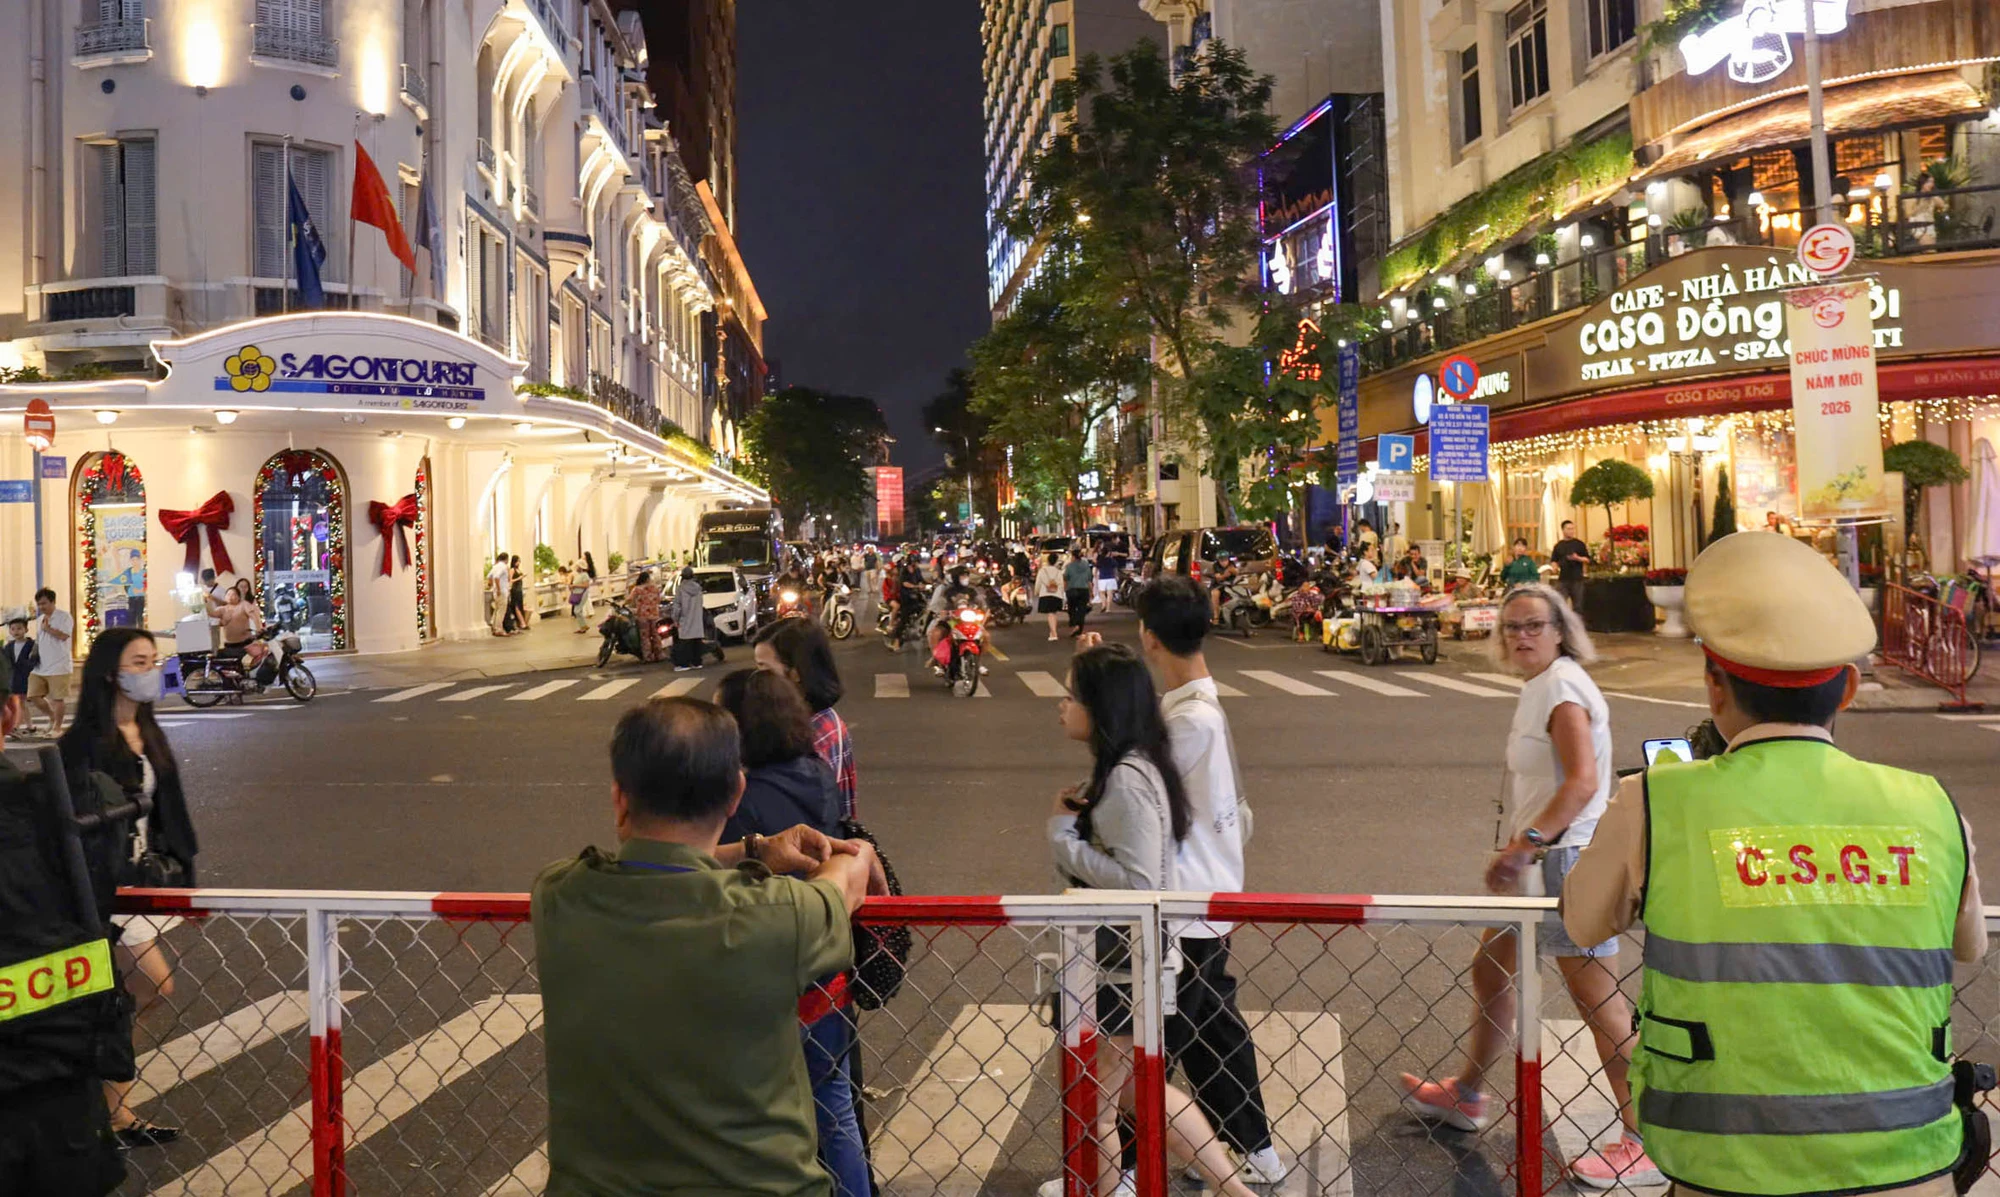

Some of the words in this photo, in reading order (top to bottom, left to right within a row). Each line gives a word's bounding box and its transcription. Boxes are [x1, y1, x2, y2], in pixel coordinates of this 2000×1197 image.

[1610, 285, 1664, 315] CAFE
[1681, 263, 1740, 303] NHÀ
[1676, 298, 1784, 342] Đồng
[280, 352, 477, 386] SAIGONTOURIST
[1581, 357, 1635, 381] STEAK
[1648, 347, 1716, 372] PIZZA
[1795, 347, 1829, 365] CHÚC
[1805, 373, 1835, 391] NĂM
[1838, 371, 1863, 387] MỚI
[1820, 400, 1852, 416] 2026
[1389, 442, 1408, 463] P
[1735, 844, 1915, 887] C.S.G.T
